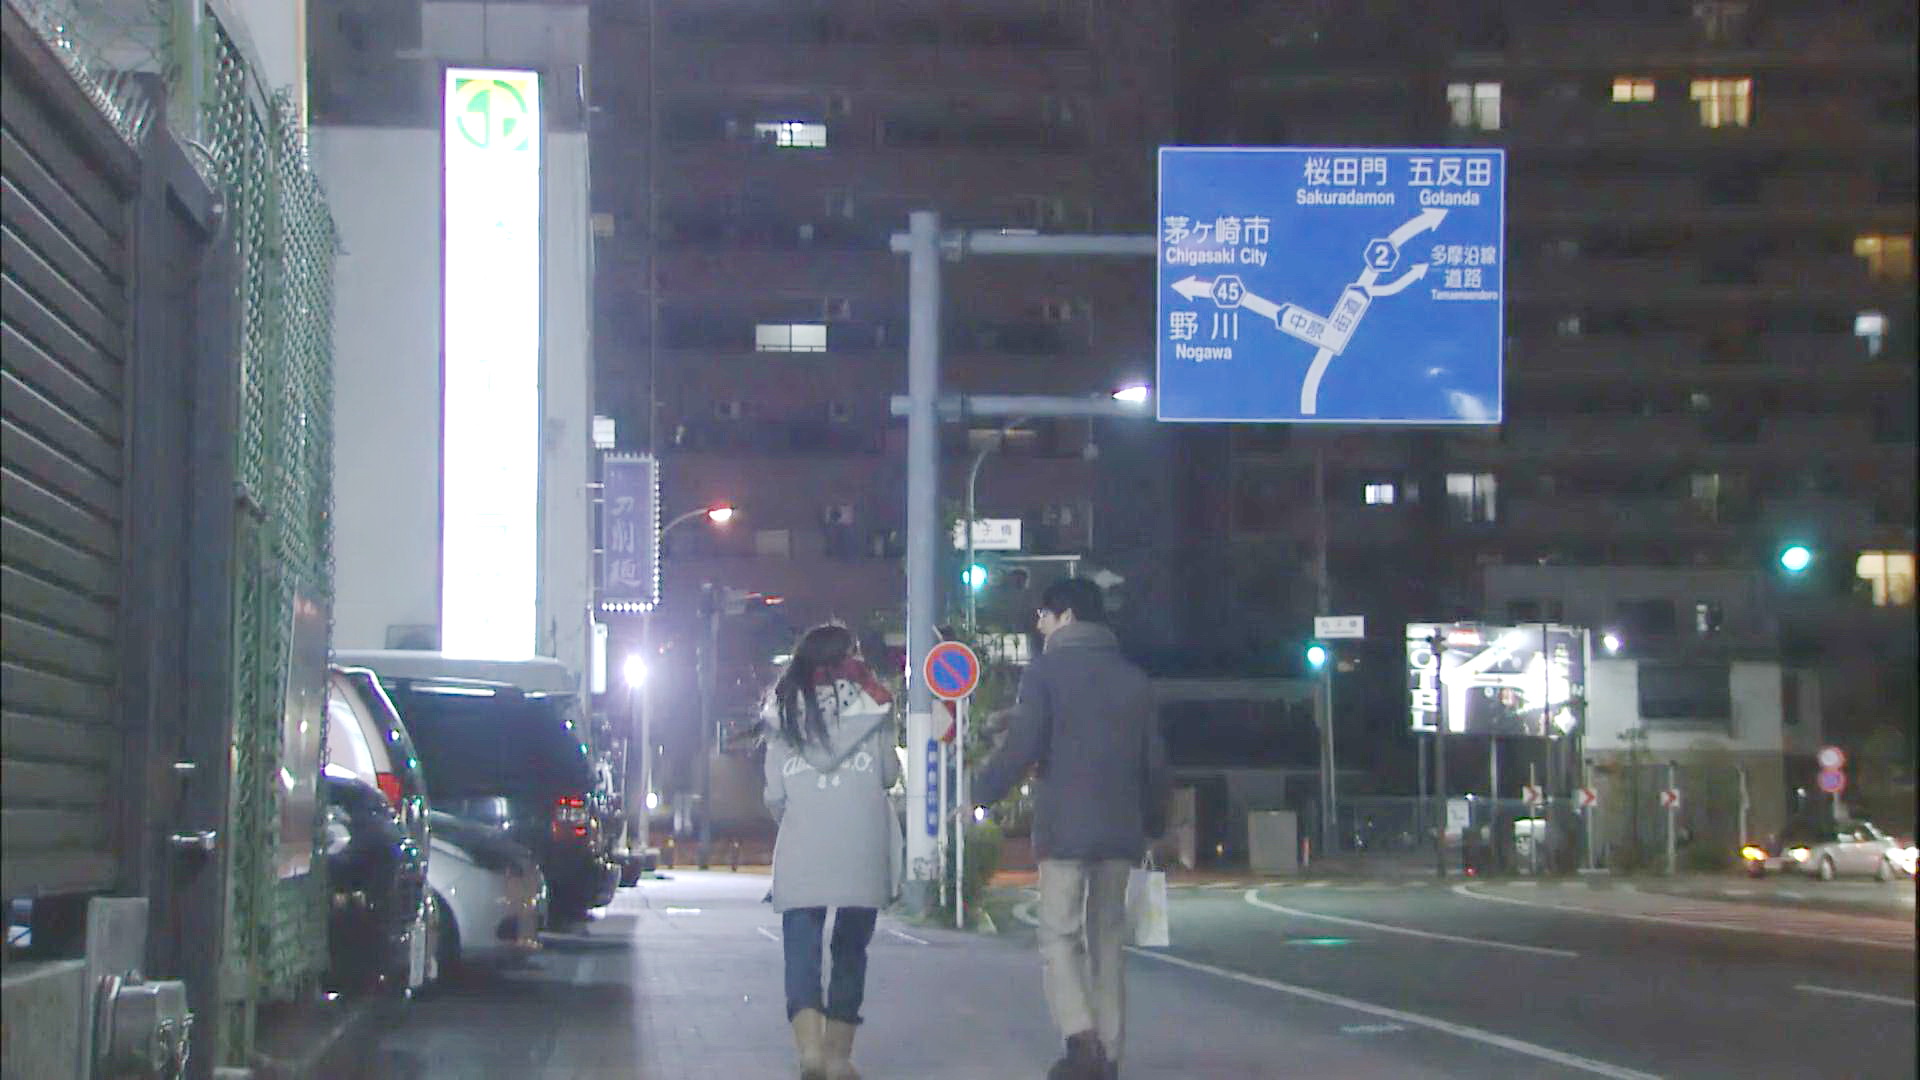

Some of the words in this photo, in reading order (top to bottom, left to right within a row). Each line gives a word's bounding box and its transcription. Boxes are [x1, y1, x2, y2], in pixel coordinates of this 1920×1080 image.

[1303, 155, 1388, 186] 桜田門
[1407, 157, 1491, 187] 五反田
[1296, 188, 1395, 205] Sakuradamon
[1419, 188, 1480, 206] Gotanda
[1166, 247, 1235, 267] Chigasaki
[1240, 247, 1268, 268] City
[1375, 244, 1389, 267] 2
[1443, 268, 1482, 289] 道路
[1216, 282, 1240, 301] 45
[1168, 310, 1239, 341] 野川
[1175, 343, 1233, 362] Nogawa
